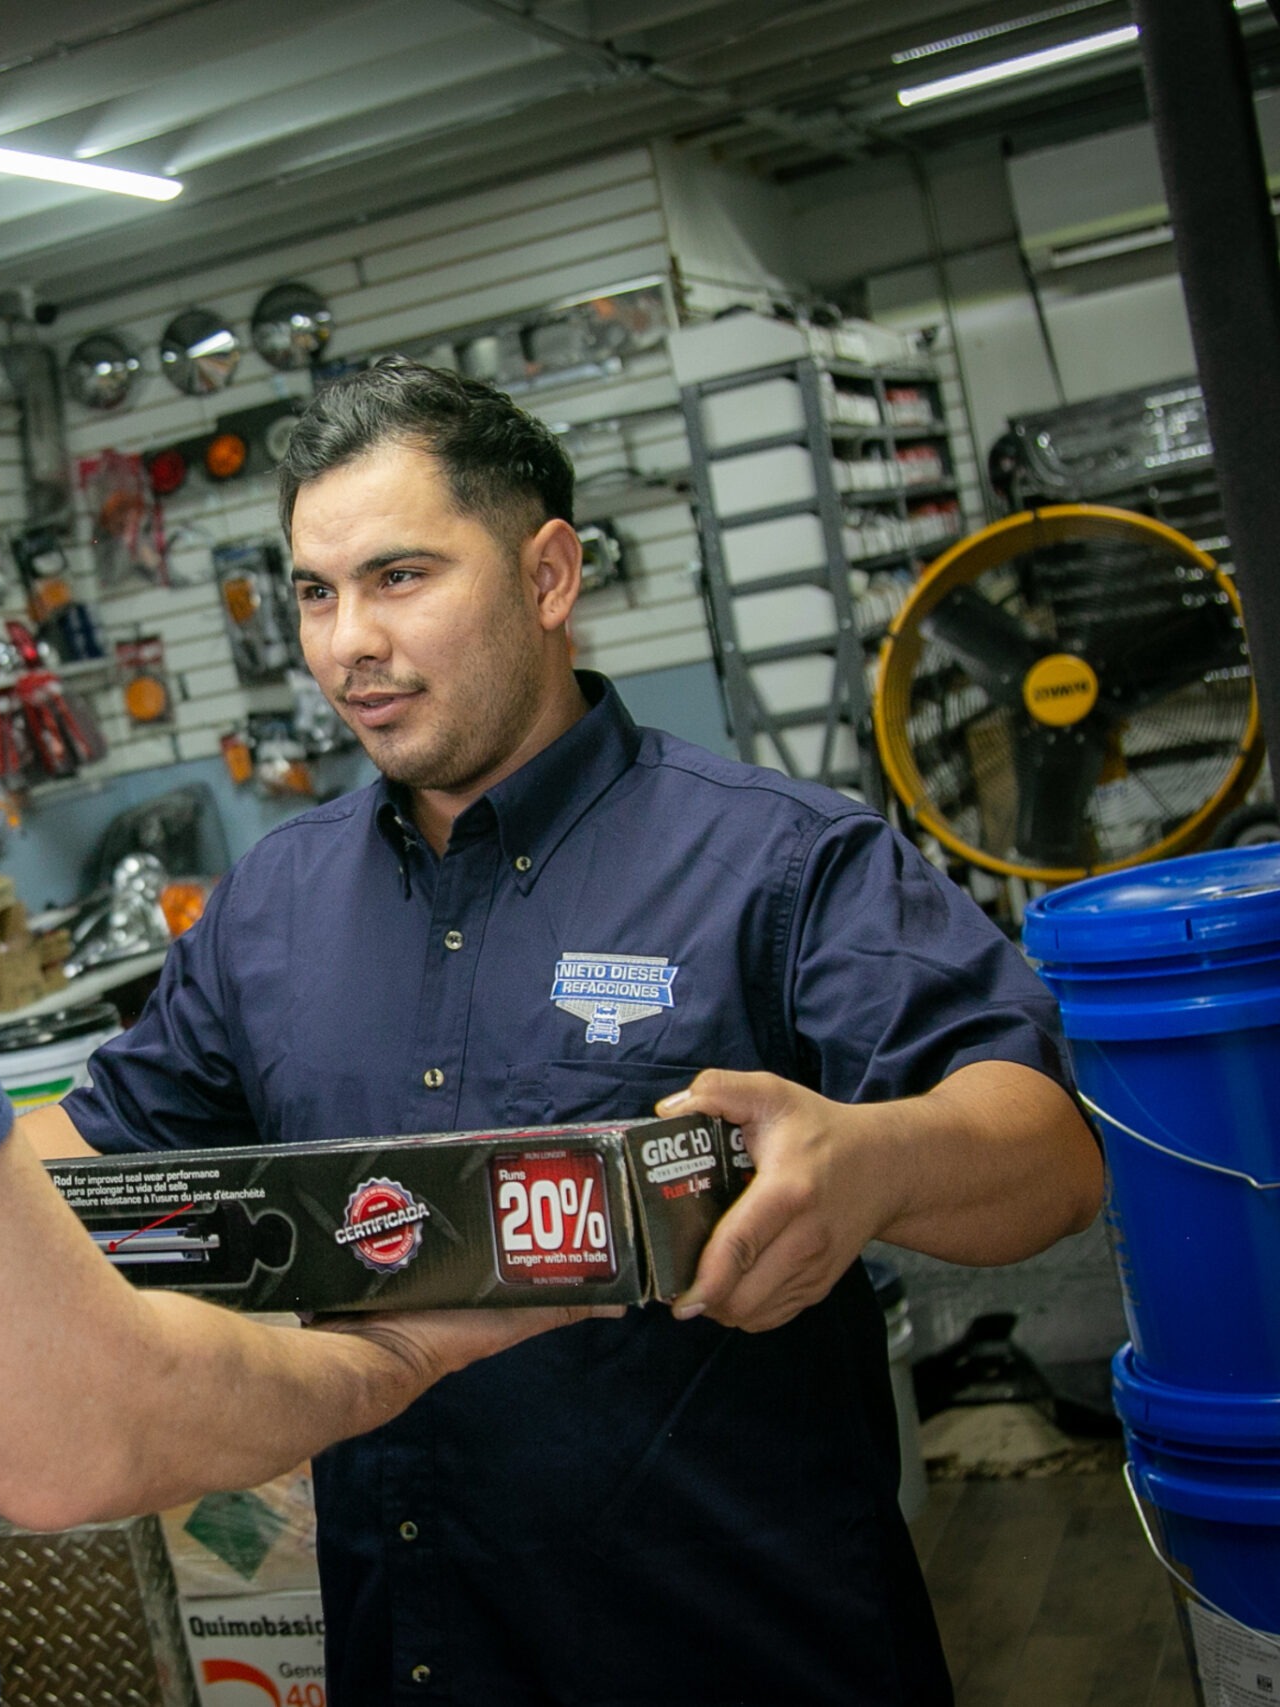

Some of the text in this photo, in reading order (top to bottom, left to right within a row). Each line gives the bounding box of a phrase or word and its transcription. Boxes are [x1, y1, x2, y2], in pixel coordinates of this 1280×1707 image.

[560, 964, 669, 983] NIETO DIESEL
[562, 982, 660, 998] REFACCIONES
[641, 1132, 689, 1167] GRC
[689, 1127, 712, 1156] HD
[53, 1169, 220, 1186] Rod for improved seal wear performance
[498, 1169, 526, 1181] Runs
[67, 1188, 86, 1198] para
[87, 1185, 124, 1197] prolongar
[126, 1184, 134, 1193] la
[135, 1183, 152, 1193] vida
[154, 1182, 167, 1192] del
[168, 1181, 188, 1191] sello
[144, 1195, 150, 1204] à
[181, 1192, 192, 1202] du
[193, 1191, 212, 1203] joint
[334, 1202, 430, 1244] CERTIFICADA
[499, 1178, 607, 1251] 20%
[506, 1250, 608, 1267] Longer with no fade
